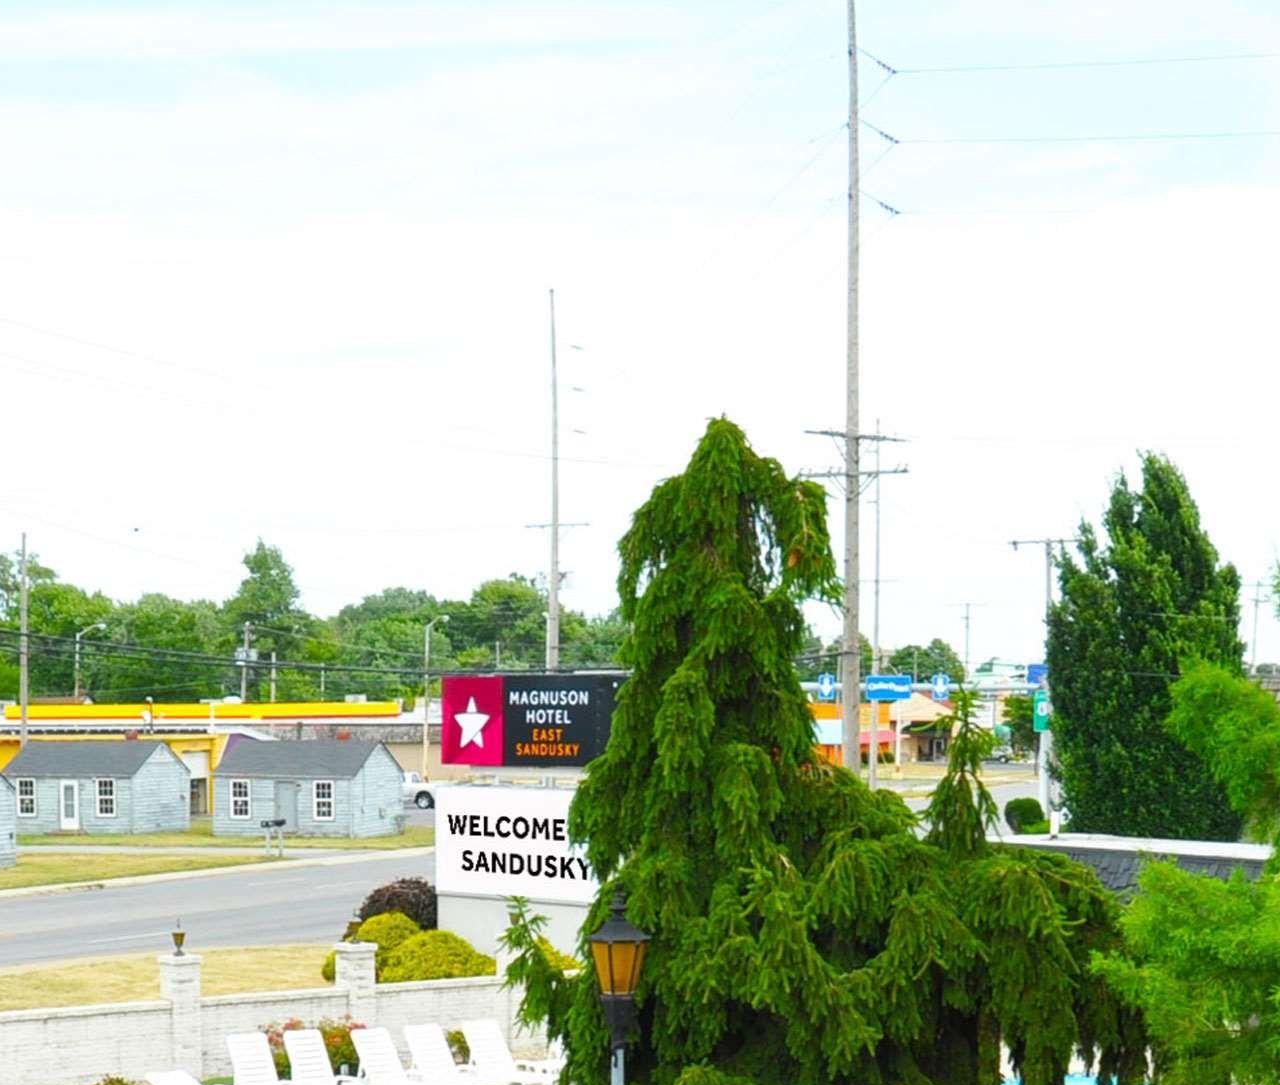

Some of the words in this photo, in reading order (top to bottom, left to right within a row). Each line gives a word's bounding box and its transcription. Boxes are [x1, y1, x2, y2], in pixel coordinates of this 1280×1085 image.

[509, 690, 589, 706] MAGNUSON
[526, 709, 572, 724] HOTEL
[533, 729, 563, 742] EAST
[516, 744, 580, 757] SANDUSKY
[448, 814, 566, 841] WELCOME
[461, 850, 591, 881] SANDUSKY
